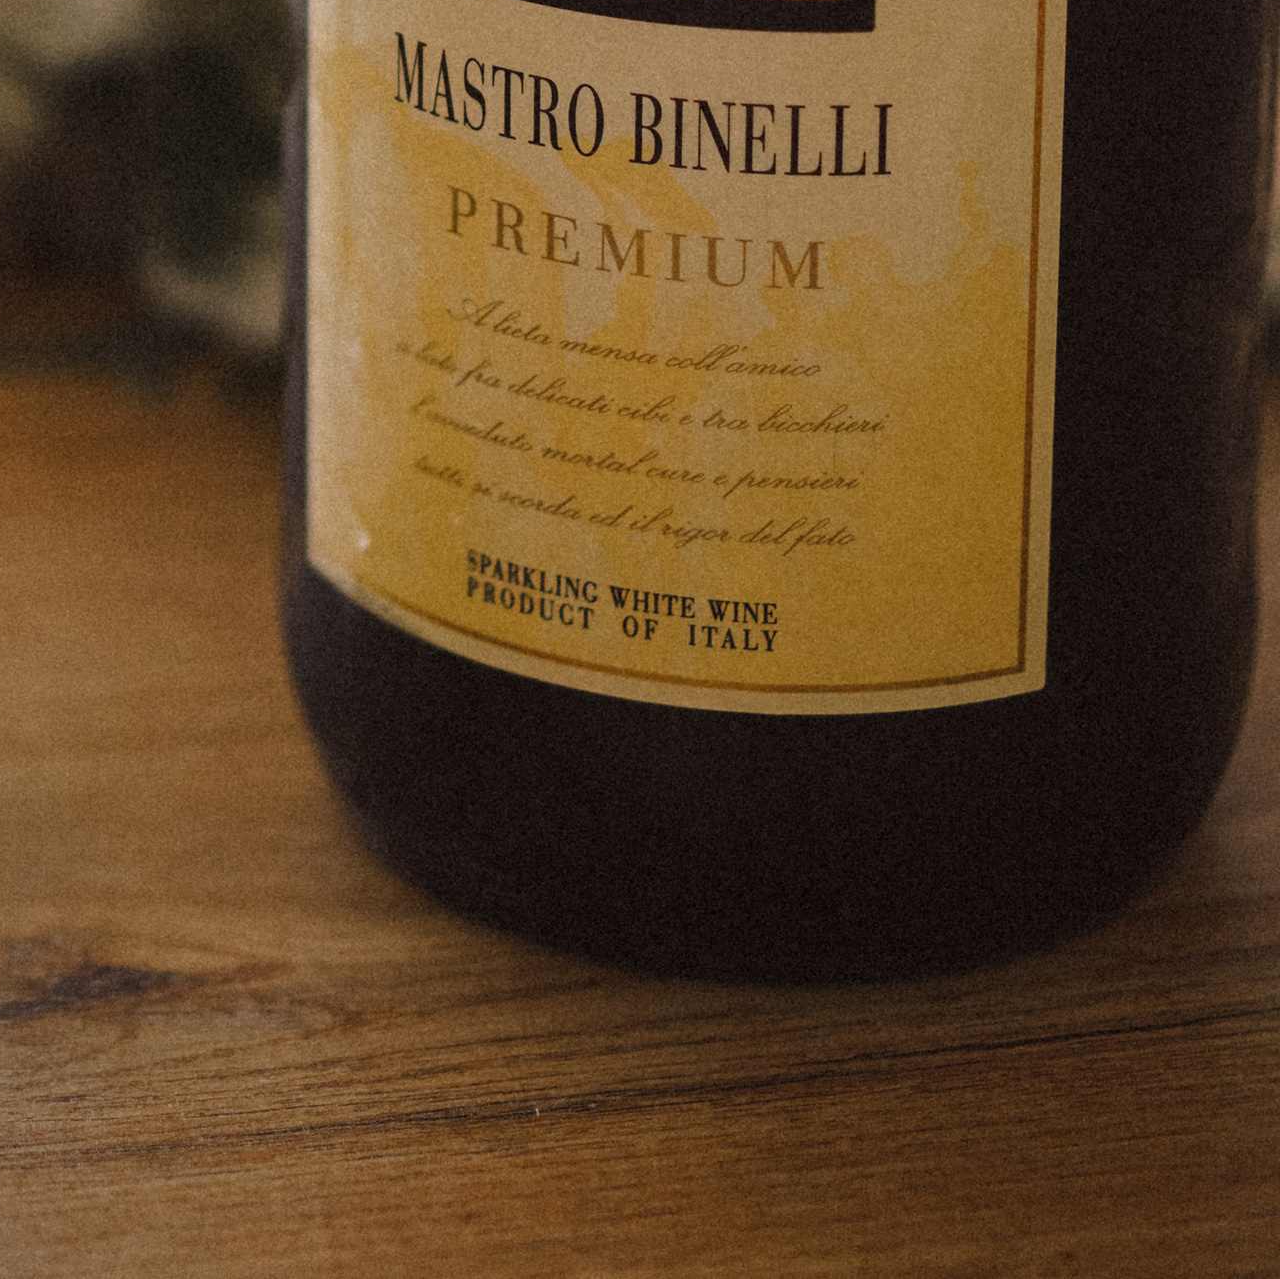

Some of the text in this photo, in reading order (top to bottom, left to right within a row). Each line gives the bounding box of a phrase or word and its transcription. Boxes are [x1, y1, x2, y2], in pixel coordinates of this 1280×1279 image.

[394, 31, 893, 176] MASTRO BINELLI
[446, 184, 826, 290] PREMIUM
[559, 339, 658, 365] mensa
[665, 343, 822, 376] coll'amico
[455, 358, 503, 388] fra
[507, 374, 615, 415] delicati
[617, 396, 675, 425] cibi
[678, 414, 694, 426] e
[703, 409, 750, 431] tra
[757, 403, 890, 433] bicchieri
[541, 445, 660, 476] mortal
[645, 467, 706, 484] cure
[713, 473, 729, 486] e
[723, 470, 865, 498] pensieri
[498, 491, 581, 521] scorda
[588, 504, 634, 528] ed
[629, 508, 673, 534] il
[662, 521, 732, 549] rigor
[740, 515, 808, 545] del
[782, 518, 856, 557] fato
[467, 548, 779, 625] SPARKLING WHITE WINE
[467, 576, 779, 652] PRODUCT OF ITALY
